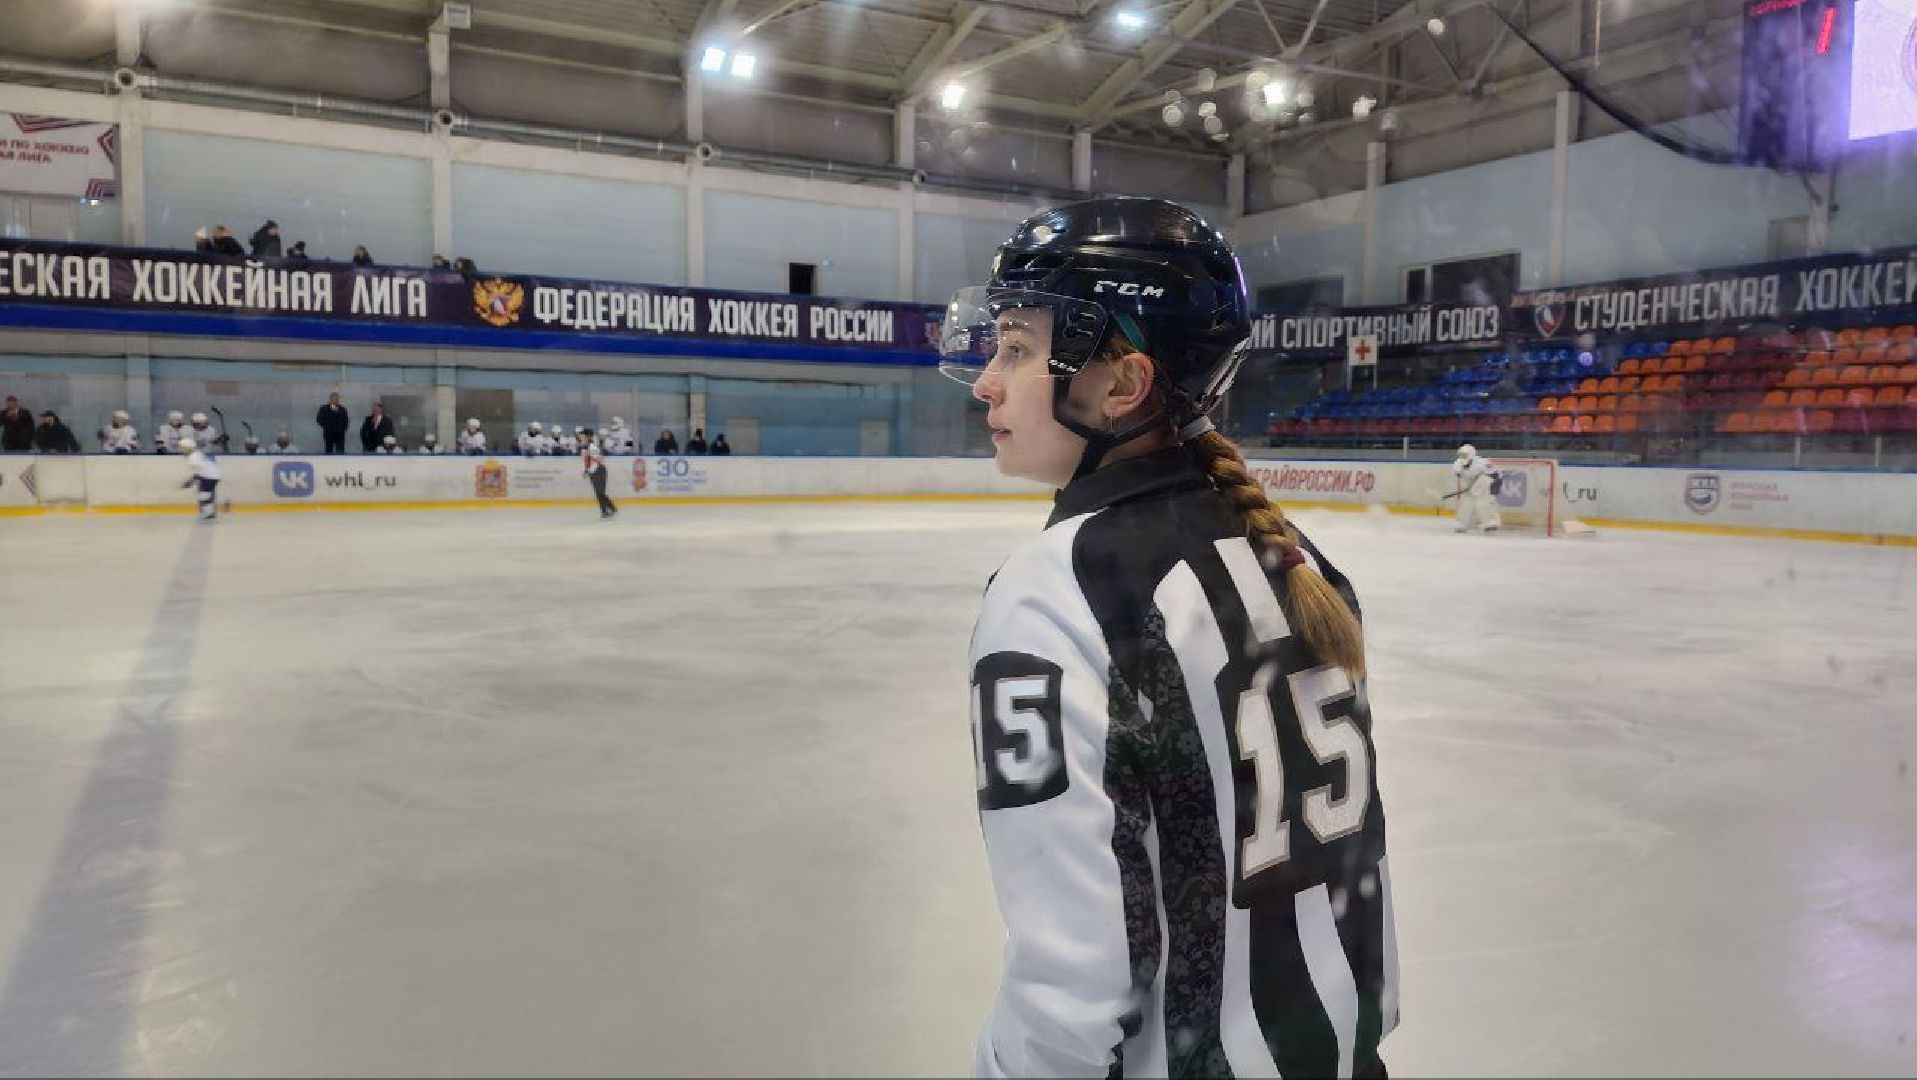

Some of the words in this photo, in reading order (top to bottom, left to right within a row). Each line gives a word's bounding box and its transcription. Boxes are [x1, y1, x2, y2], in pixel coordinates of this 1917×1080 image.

[133, 259, 334, 313] ХОККЕЙНАЯ
[350, 274, 427, 317] ЛИГА
[1093, 280, 1165, 299] CCM
[1574, 275, 1779, 332] СТУДЕНЧЕСКАЯ
[534, 287, 695, 334] ФЕДЕРАЦИЯ
[708, 300, 798, 339] ХОККЕЯ
[810, 306, 894, 342] РОССИИ
[1281, 308, 1432, 349] СПОРТИВНЫЙ
[1436, 306, 1500, 341] СОЮЗ
[324, 471, 397, 490] whl_ru
[657, 458, 689, 477] 30
[1238, 664, 1371, 880] 15
